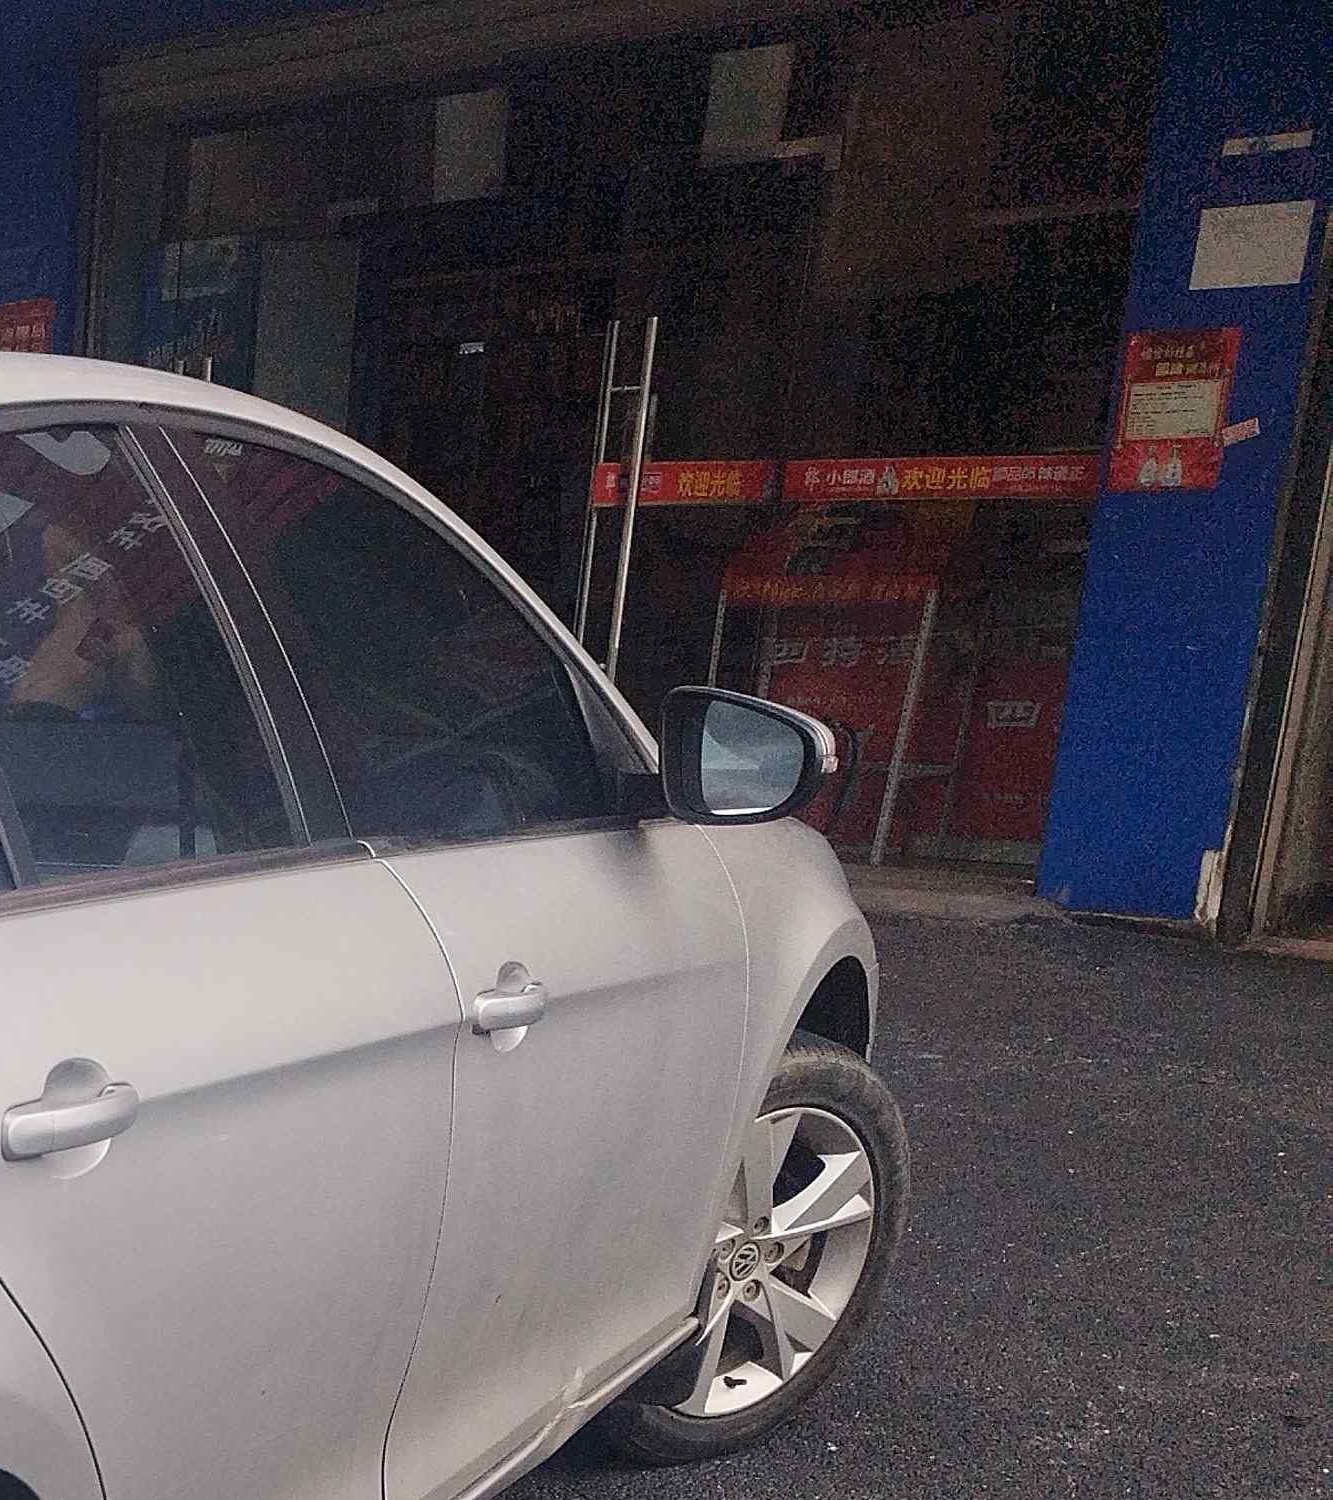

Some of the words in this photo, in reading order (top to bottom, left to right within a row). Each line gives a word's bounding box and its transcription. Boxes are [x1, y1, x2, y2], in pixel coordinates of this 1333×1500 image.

[676, 470, 742, 497] 欢迎光临
[901, 465, 991, 490] 欢迎光临
